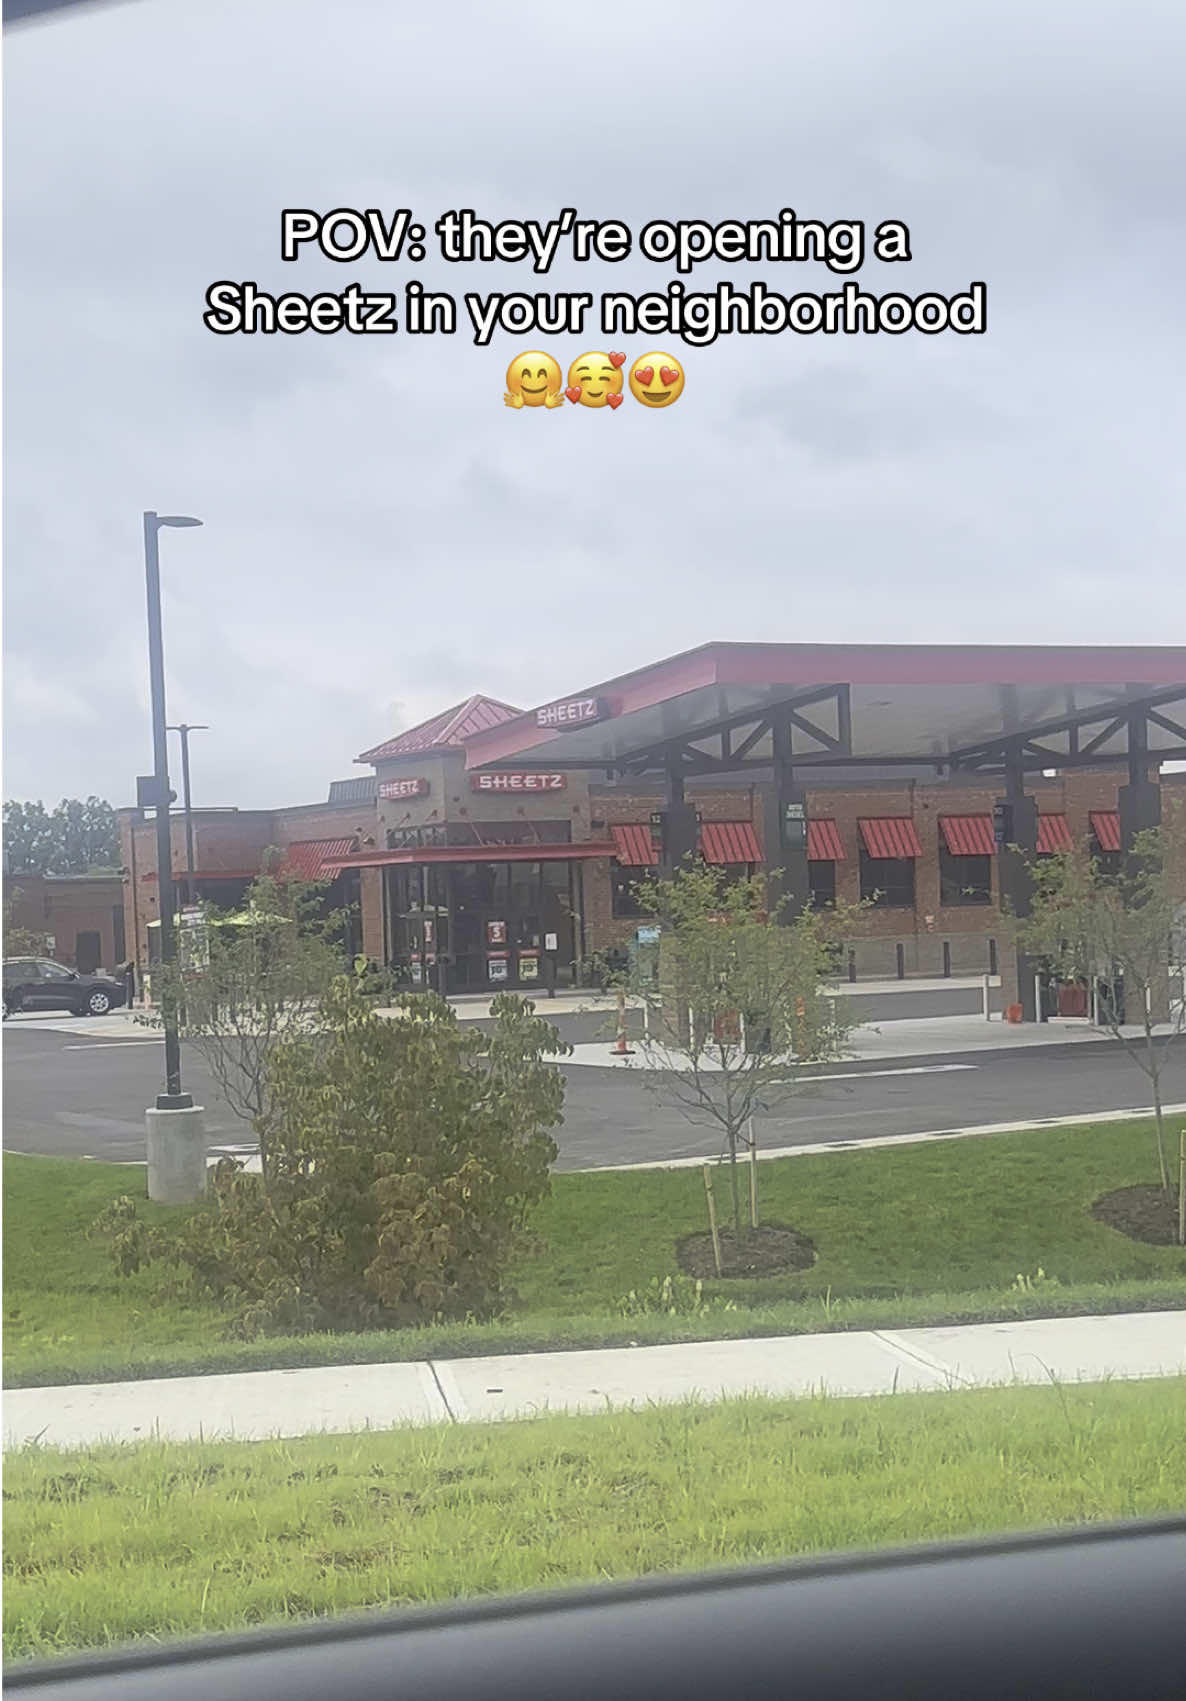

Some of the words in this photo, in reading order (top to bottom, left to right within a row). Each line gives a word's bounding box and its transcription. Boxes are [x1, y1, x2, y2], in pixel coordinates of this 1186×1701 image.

[537, 699, 595, 725] SHEETZ
[378, 780, 419, 797] SHEETZ
[479, 774, 563, 789] SHEETZ
